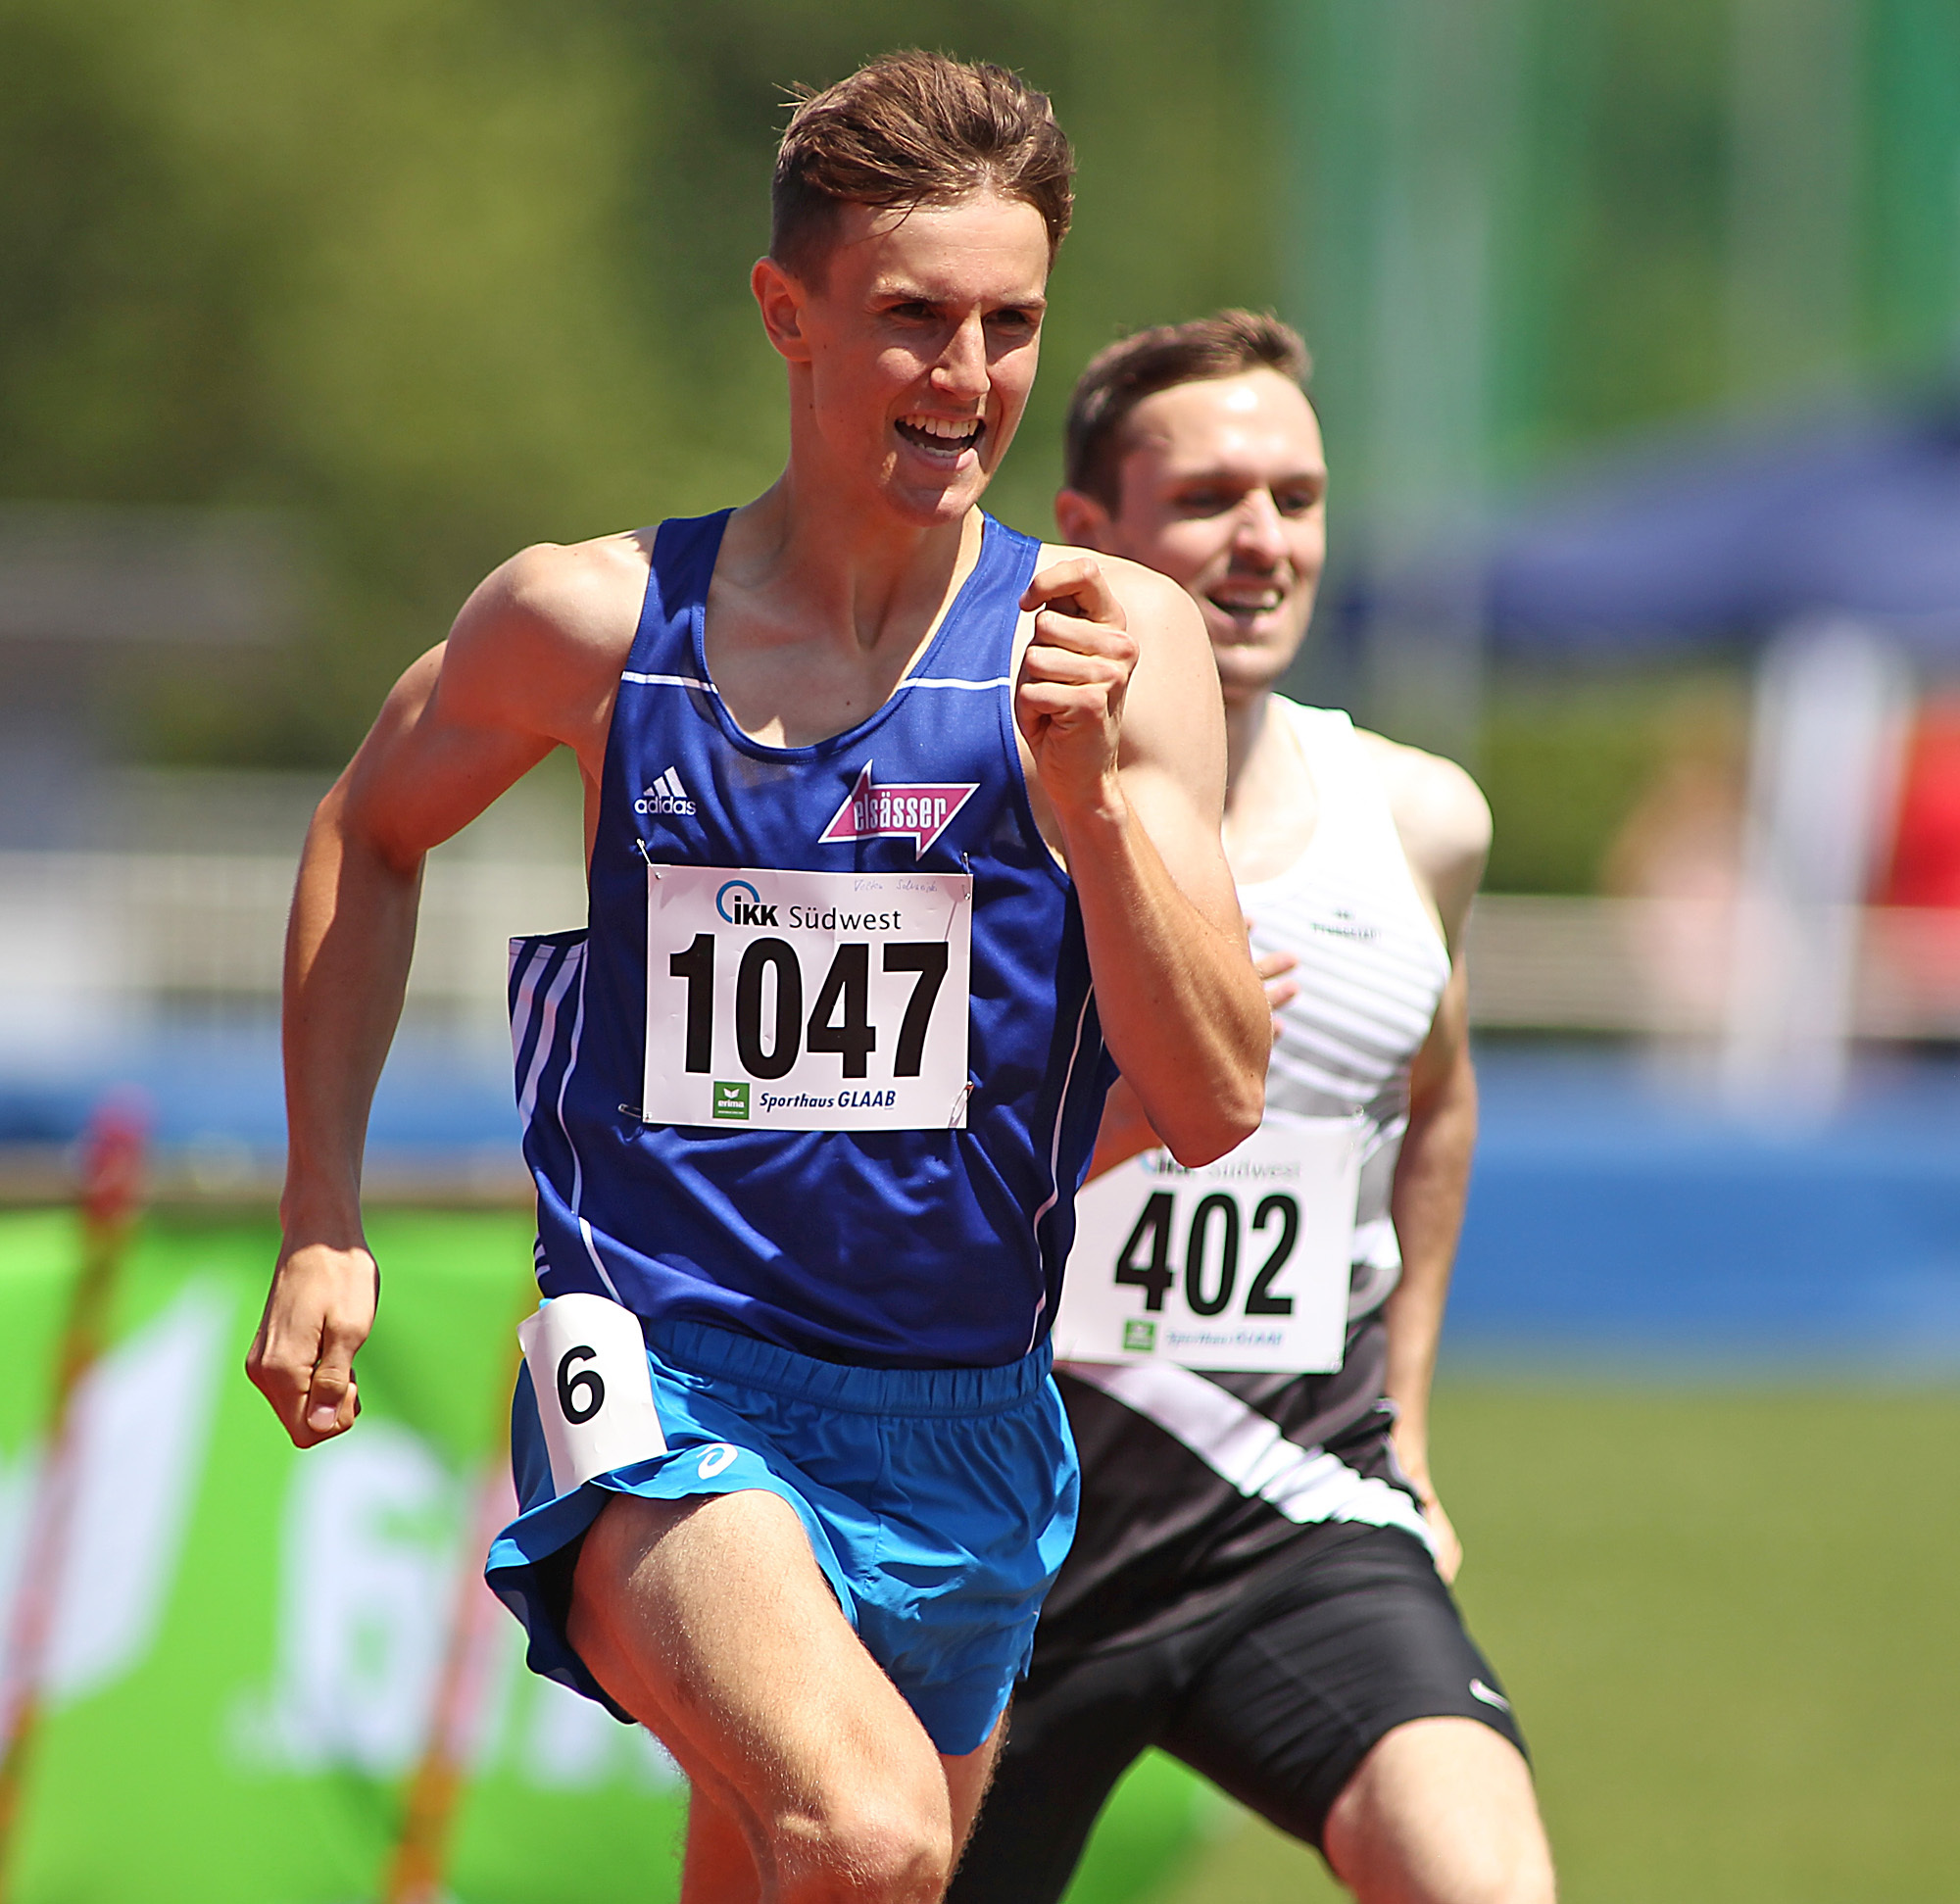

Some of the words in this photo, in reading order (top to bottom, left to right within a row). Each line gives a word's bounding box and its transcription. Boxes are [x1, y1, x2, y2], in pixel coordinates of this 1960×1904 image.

[634, 796, 697, 815] adidas
[854, 791, 947, 831] elsässer
[789, 905, 902, 930] Südwest
[669, 933, 950, 1080] 1047
[760, 1092, 834, 1113] Sporthaus
[838, 1090, 896, 1107] GLAAB
[1114, 1191, 1299, 1316] 402
[556, 1344, 606, 1425] 6
